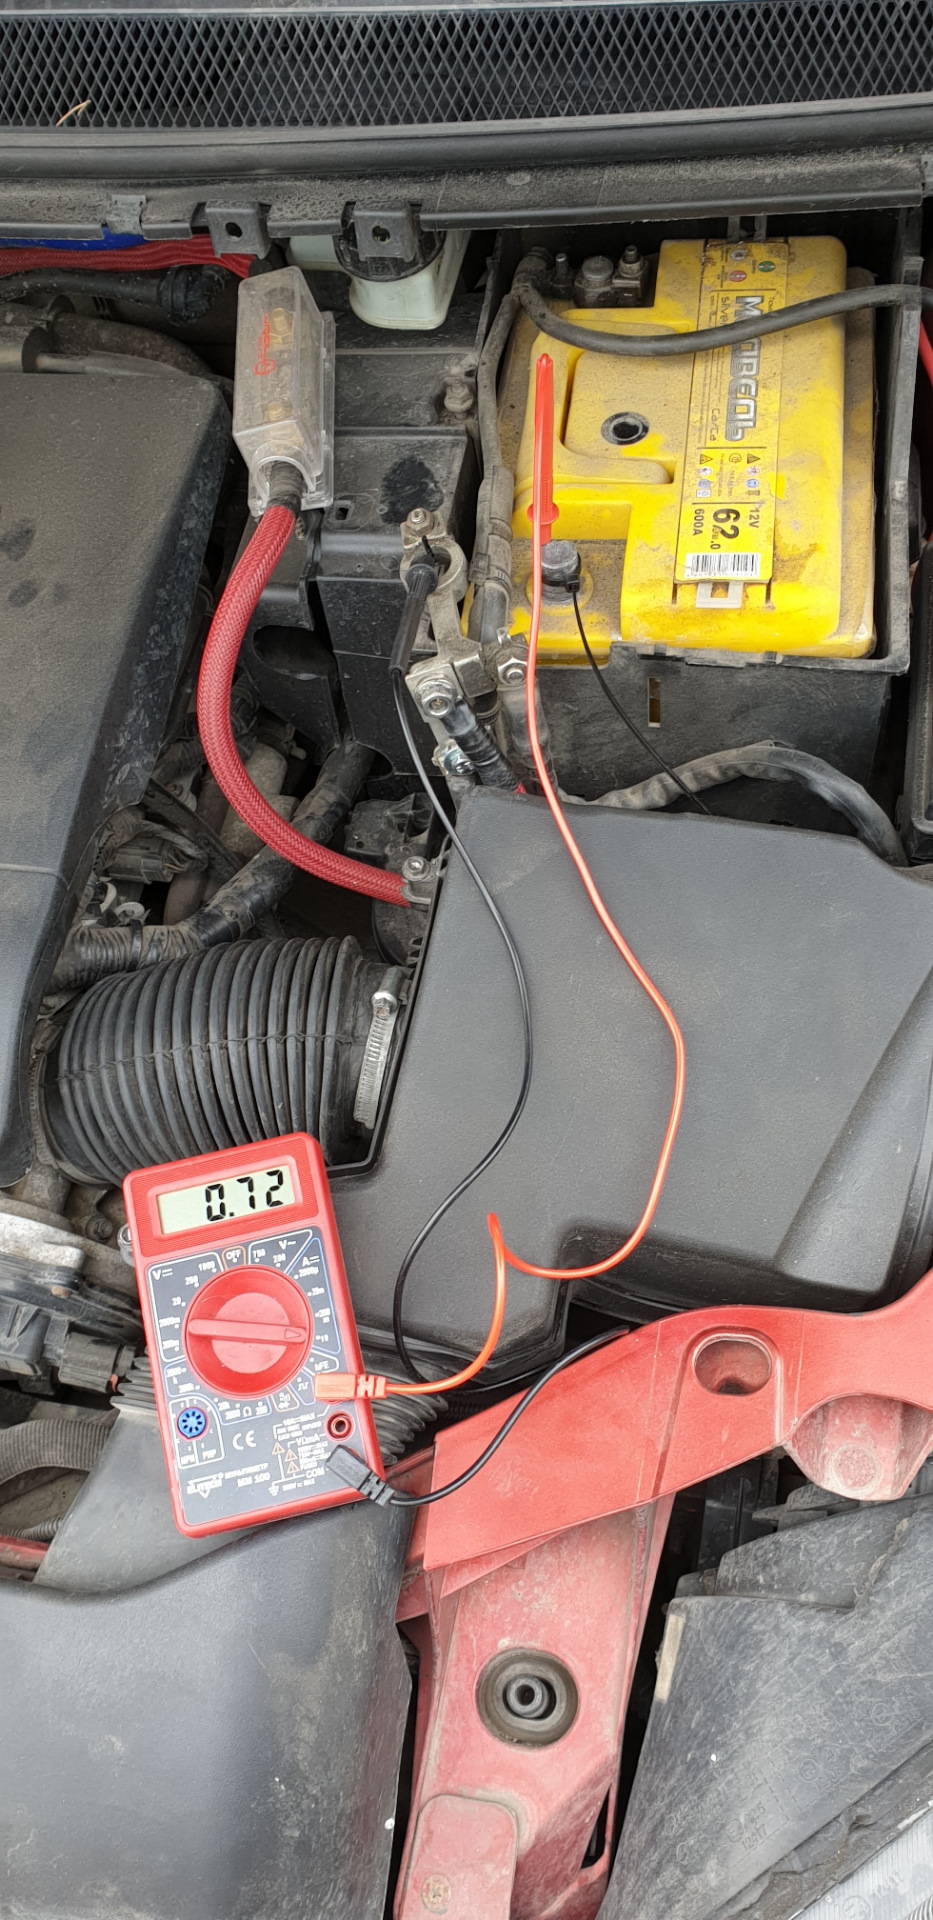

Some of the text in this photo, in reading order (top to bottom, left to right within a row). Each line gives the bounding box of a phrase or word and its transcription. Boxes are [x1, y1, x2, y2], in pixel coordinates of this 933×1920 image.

[693, 508, 705, 536] 600A
[749, 507, 760, 528] 12V
[205, 1169, 284, 1221] 0.72
[226, 1249, 242, 1260] OFF
[273, 1253, 286, 1263] 200
[185, 1275, 199, 1286] 200
[172, 1297, 182, 1307] 20
[305, 1467, 326, 1479] COM
